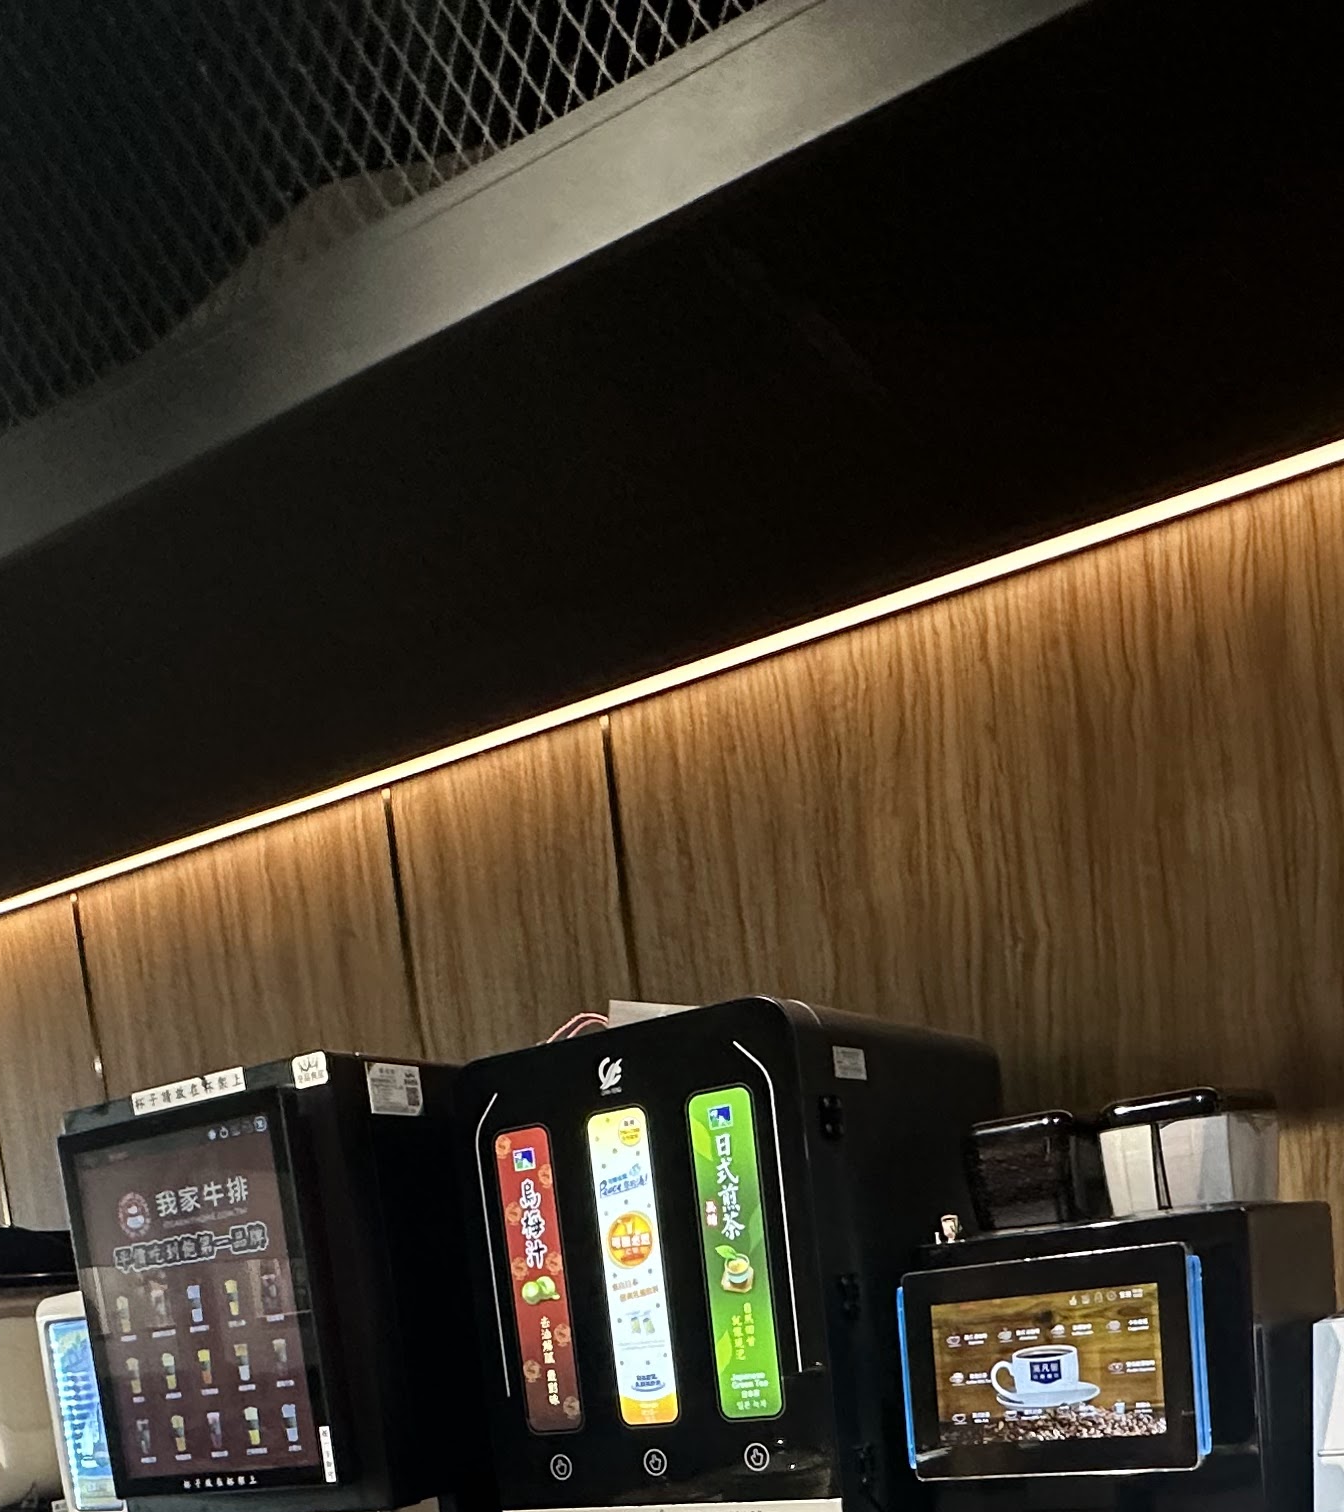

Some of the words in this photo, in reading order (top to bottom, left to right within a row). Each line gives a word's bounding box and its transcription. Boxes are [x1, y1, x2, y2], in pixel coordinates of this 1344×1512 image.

[155, 1175, 248, 1217] 我家牛排
[520, 1179, 546, 1269] 烏梅汁
[715, 1133, 745, 1240] 日式煎茶
